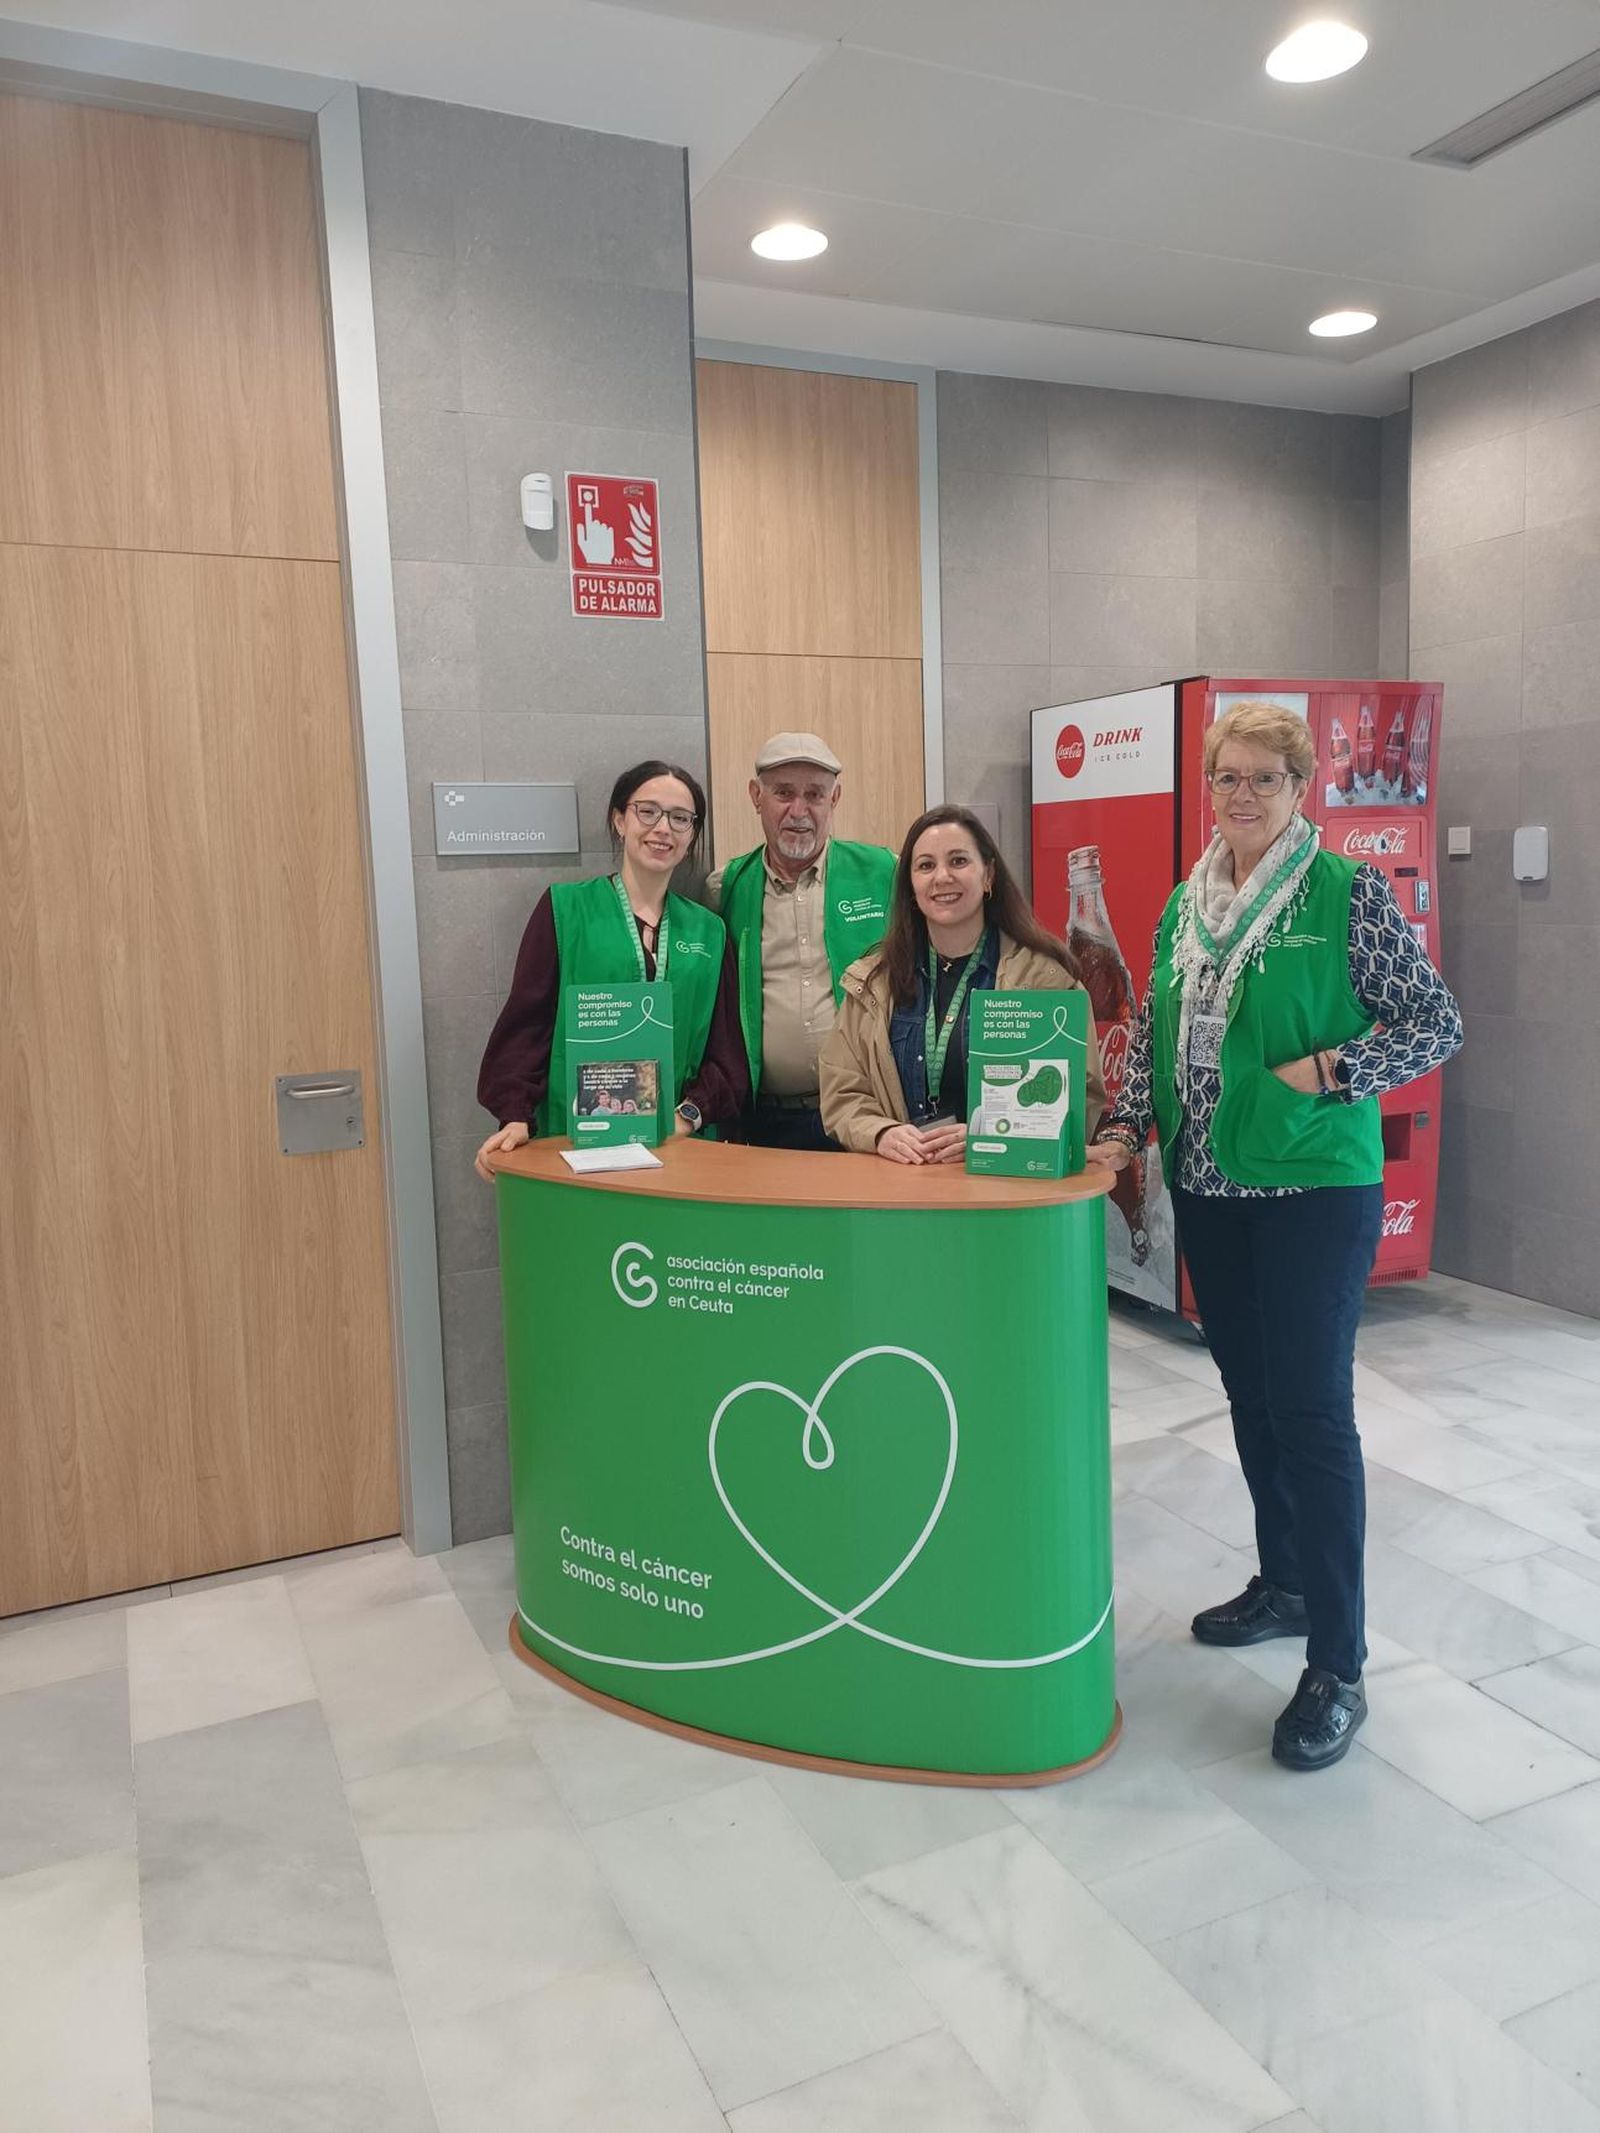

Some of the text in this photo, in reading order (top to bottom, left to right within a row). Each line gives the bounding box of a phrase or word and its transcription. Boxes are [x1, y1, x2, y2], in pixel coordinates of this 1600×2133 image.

[579, 579, 656, 596] PULSADOR
[580, 595, 657, 613] DE ALARMA
[1093, 727, 1143, 747] DRINK
[1116, 751, 1141, 760] COLD
[447, 829, 545, 842] Administración
[578, 992, 613, 1001] Nuestro
[578, 1000, 633, 1010] compromiso
[984, 999, 1022, 1008] Nuestro
[608, 1009, 622, 1017] las
[984, 1009, 1044, 1020] compromiso
[578, 1019, 618, 1029] personas
[1016, 1019, 1030, 1028] las
[983, 1031, 1027, 1040] personas
[666, 1256, 824, 1281] asociación española
[667, 1276, 790, 1299] contra el cáncer
[668, 1295, 734, 1315] en Ceuta
[560, 1525, 712, 1590] Contra el cáncer
[562, 1559, 704, 1619] somos solo uno
